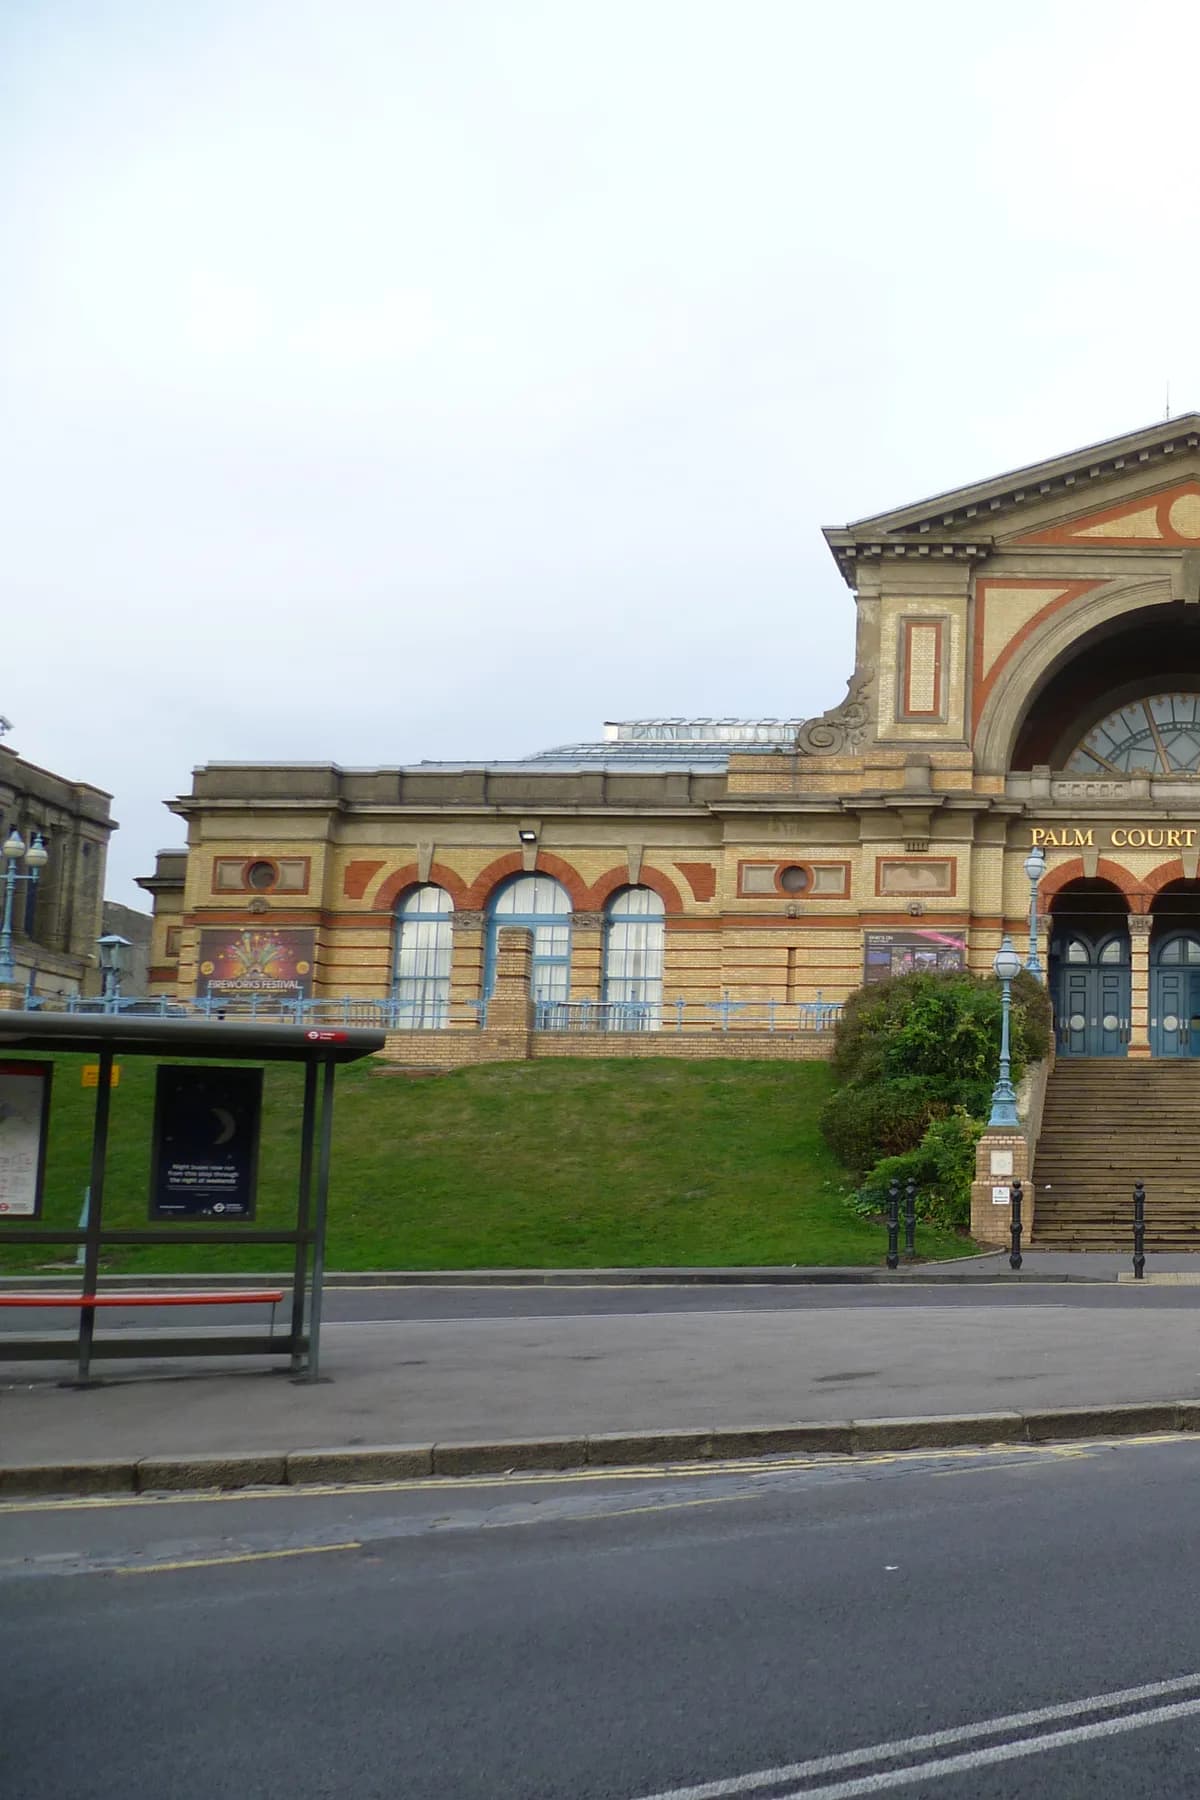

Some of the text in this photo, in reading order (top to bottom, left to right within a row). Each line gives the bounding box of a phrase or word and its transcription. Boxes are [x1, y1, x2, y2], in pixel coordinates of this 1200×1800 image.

[1030, 828, 1094, 846] PALM
[1110, 828, 1197, 848] COURT
[208, 979, 299, 989] FIREWORKS FESTIVAL
